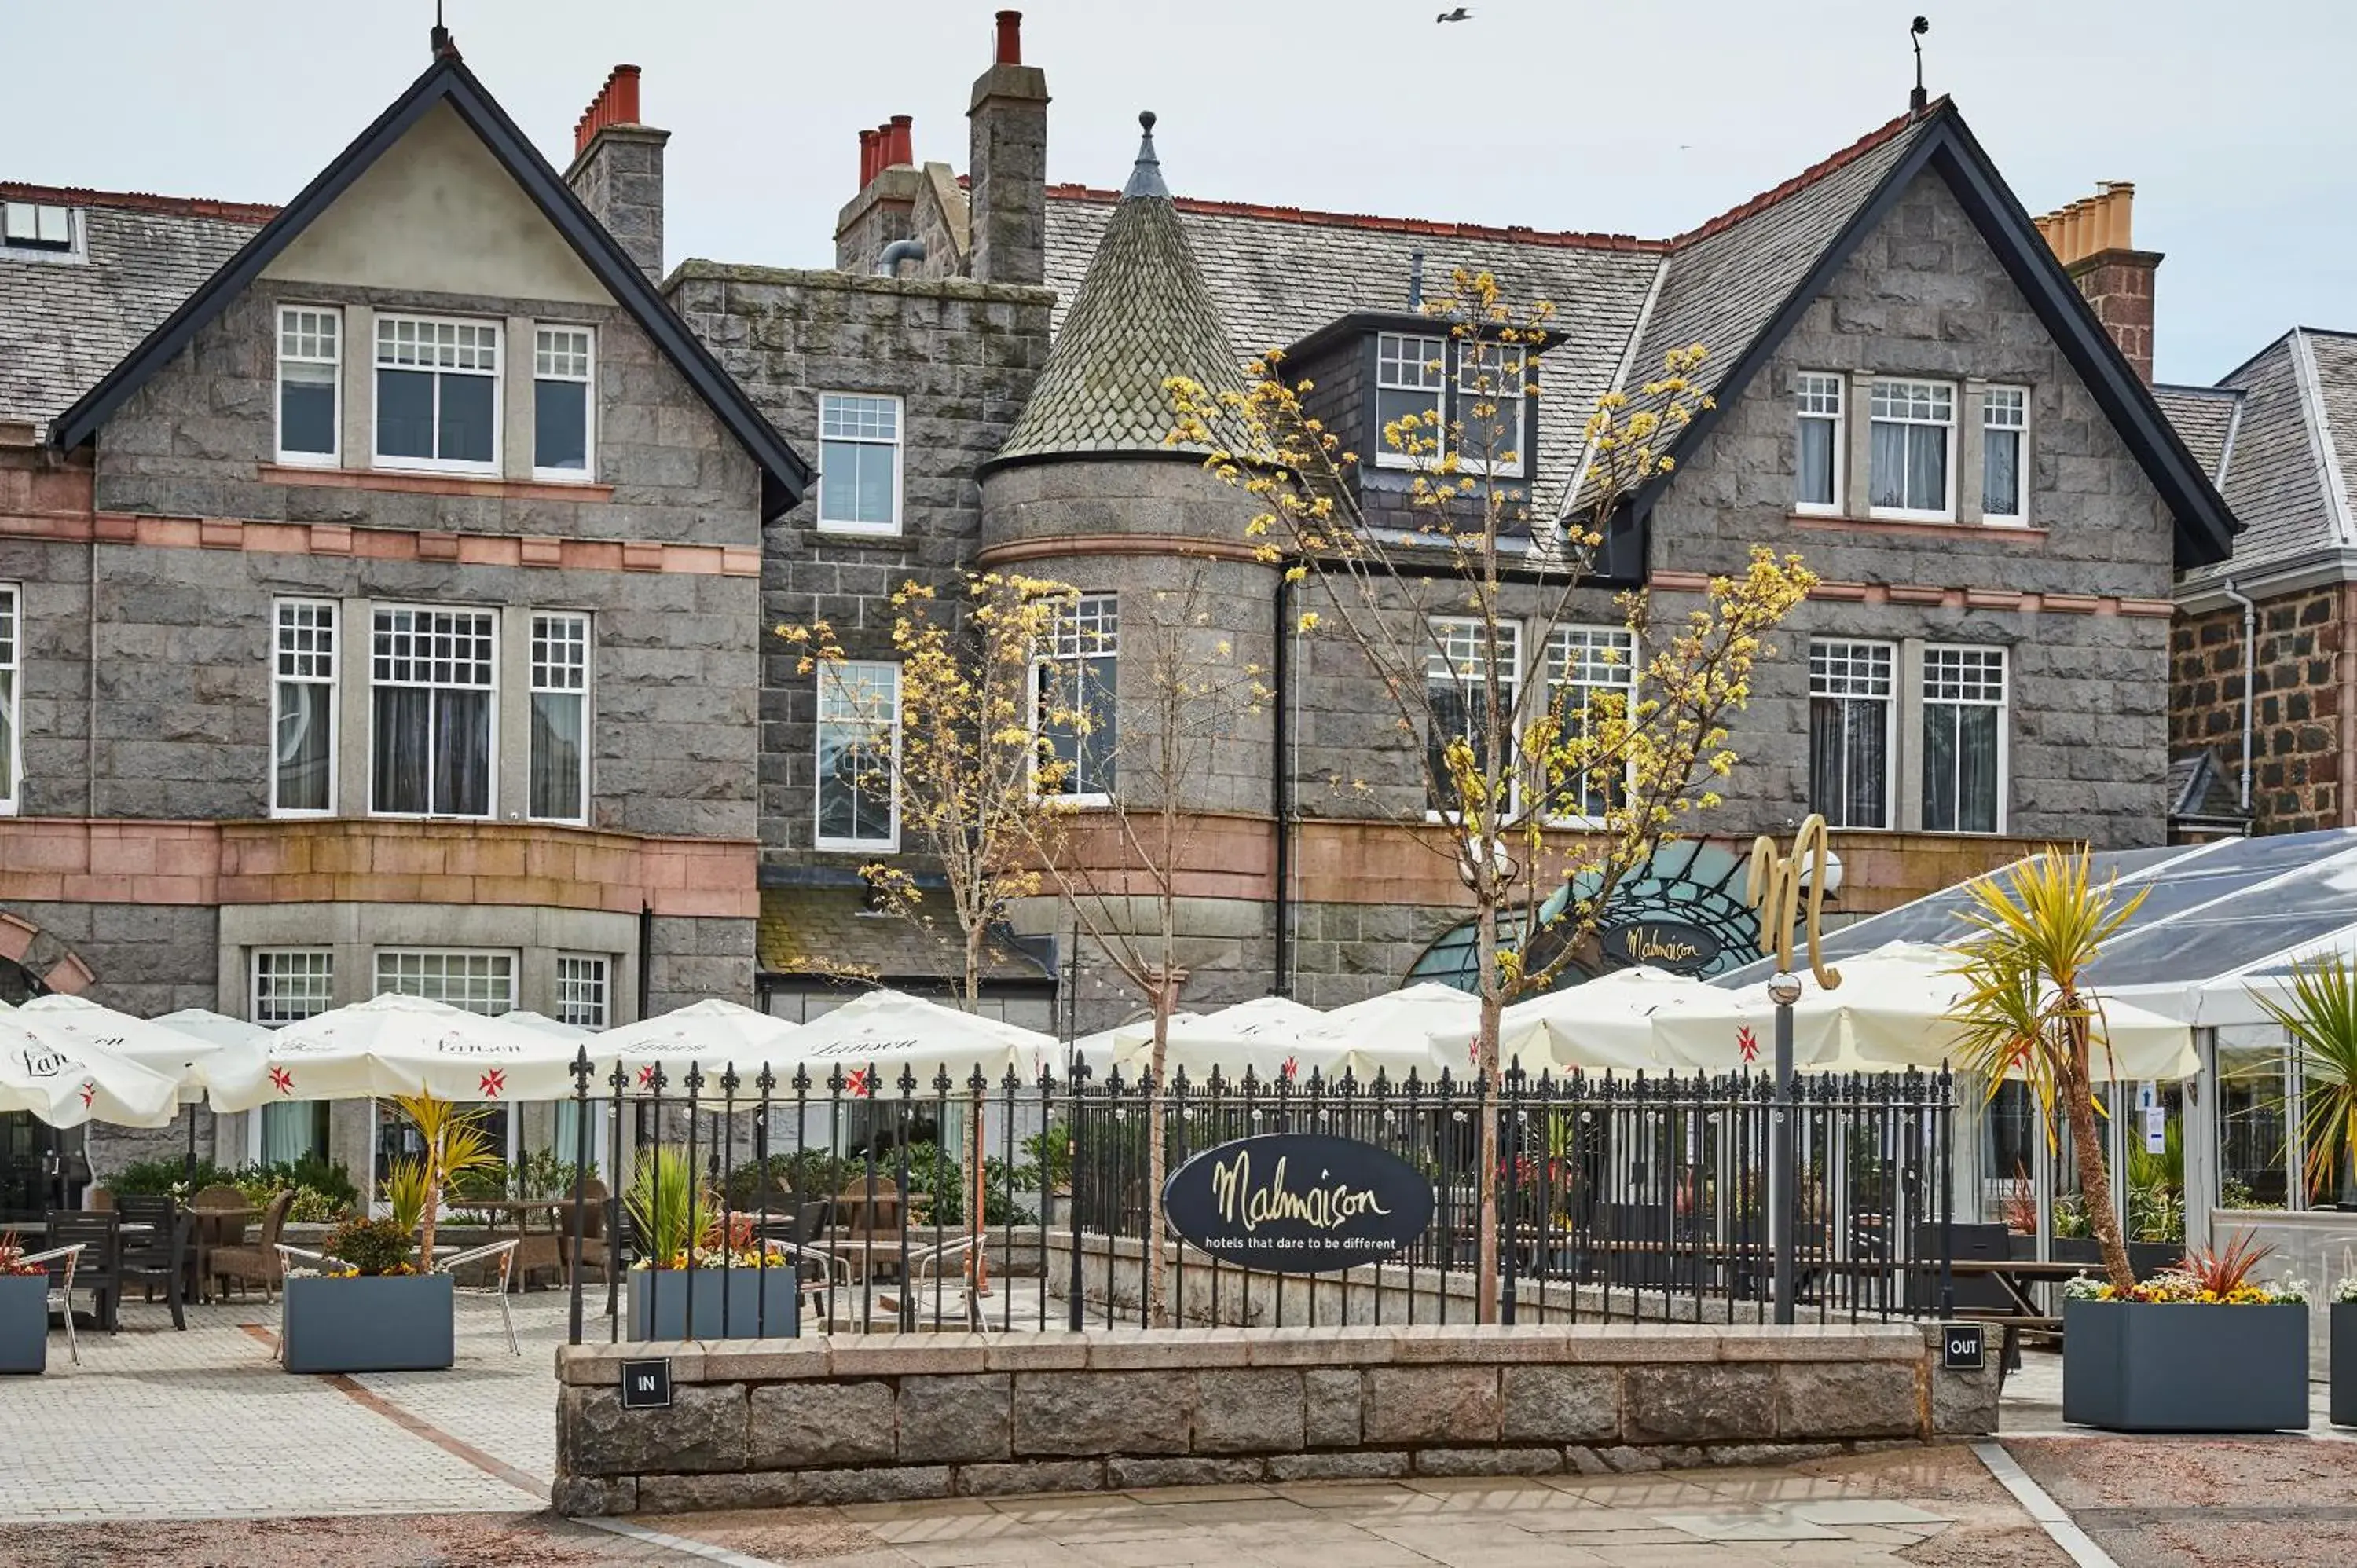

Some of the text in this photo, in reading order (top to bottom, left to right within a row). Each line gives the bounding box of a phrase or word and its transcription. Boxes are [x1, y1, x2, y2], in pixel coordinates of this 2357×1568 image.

[1626, 926, 1703, 962] Malmaison
[1213, 1149, 1391, 1231] Malmaison
[1206, 1236, 1396, 1249] hotels that dare to be different
[1951, 1340, 1977, 1354] OUT
[638, 1376, 654, 1391] IN
